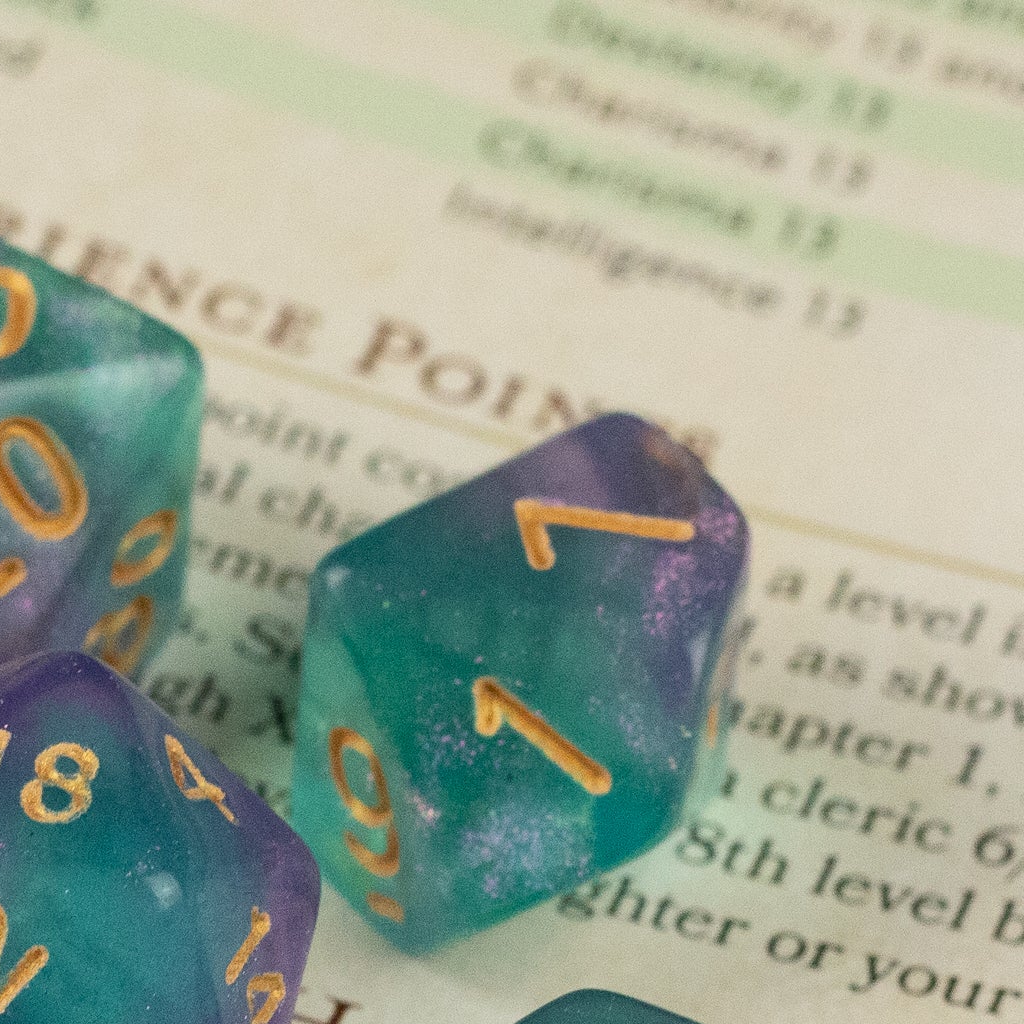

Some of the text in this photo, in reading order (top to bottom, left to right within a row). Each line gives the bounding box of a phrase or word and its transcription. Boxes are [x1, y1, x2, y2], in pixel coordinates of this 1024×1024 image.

[204, 400, 349, 468] oint
[352, 317, 719, 468] POIN
[760, 776, 953, 855] cleric
[674, 820, 790, 887] 8th
[810, 854, 975, 933] level
[765, 930, 845, 971] or
[847, 952, 1023, 1017] your
